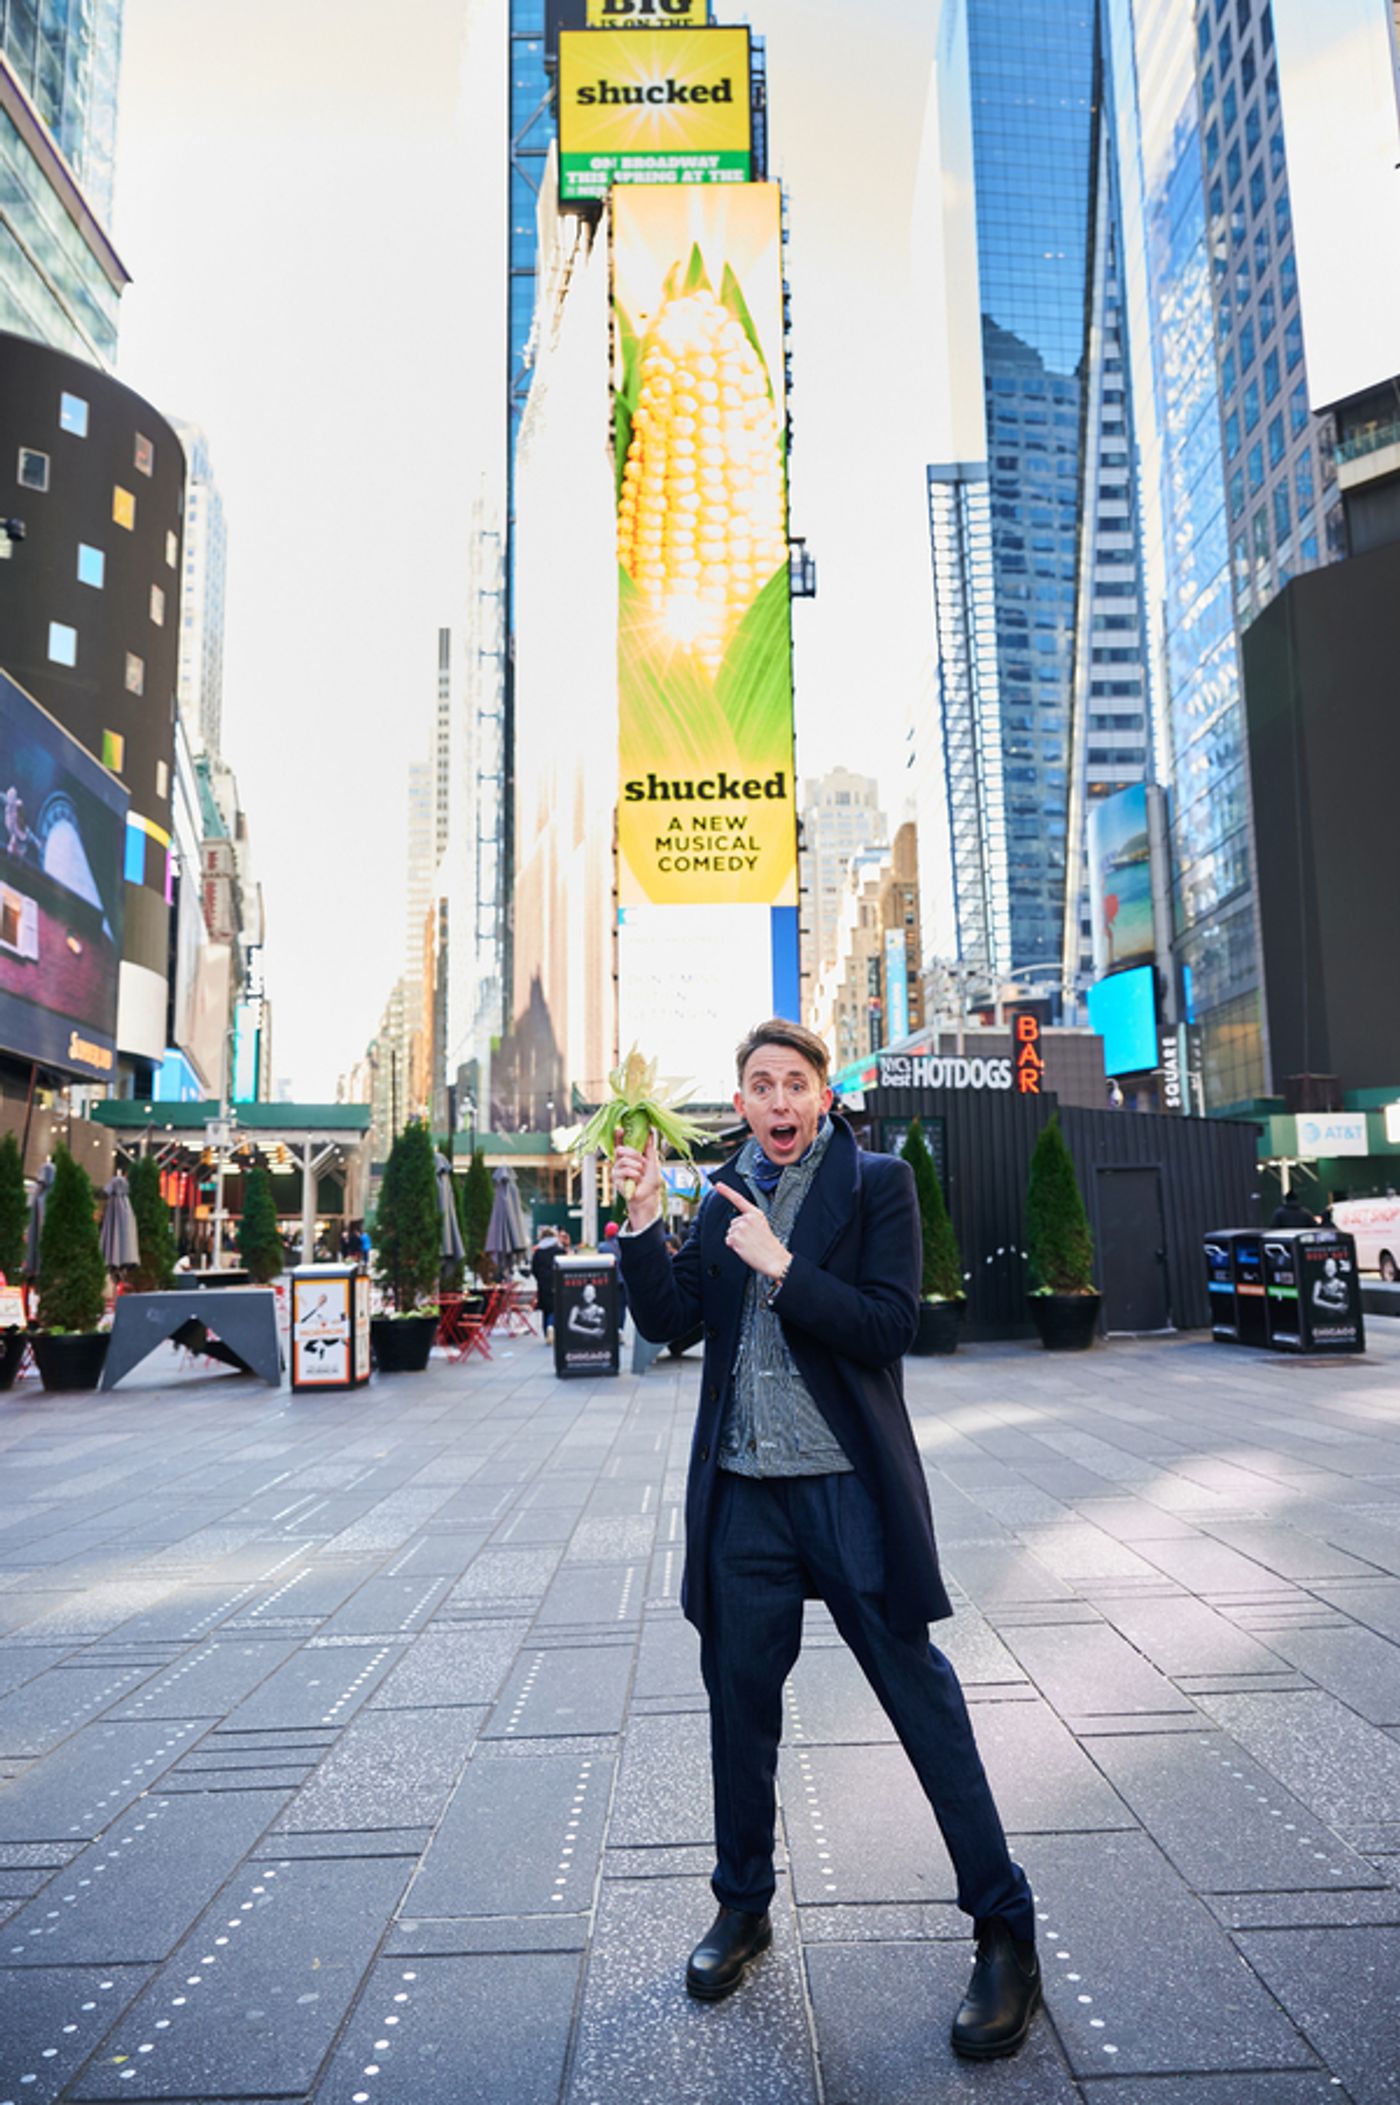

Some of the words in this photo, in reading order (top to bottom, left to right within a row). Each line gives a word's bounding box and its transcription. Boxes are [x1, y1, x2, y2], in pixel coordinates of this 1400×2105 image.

[576, 78, 734, 106] shucked
[620, 156, 720, 169] BROADWAY
[624, 772, 787, 801] shucked
[667, 816, 683, 831] A
[692, 816, 748, 831] NEW
[655, 836, 761, 852] MUSICAL
[658, 856, 759, 872] COMEDY
[1016, 1015, 1041, 1094] BAR
[912, 1057, 1013, 1090] HOTDOGS
[1162, 1037, 1180, 1107] SQUARE
[1324, 1125, 1363, 1140] AT&T
